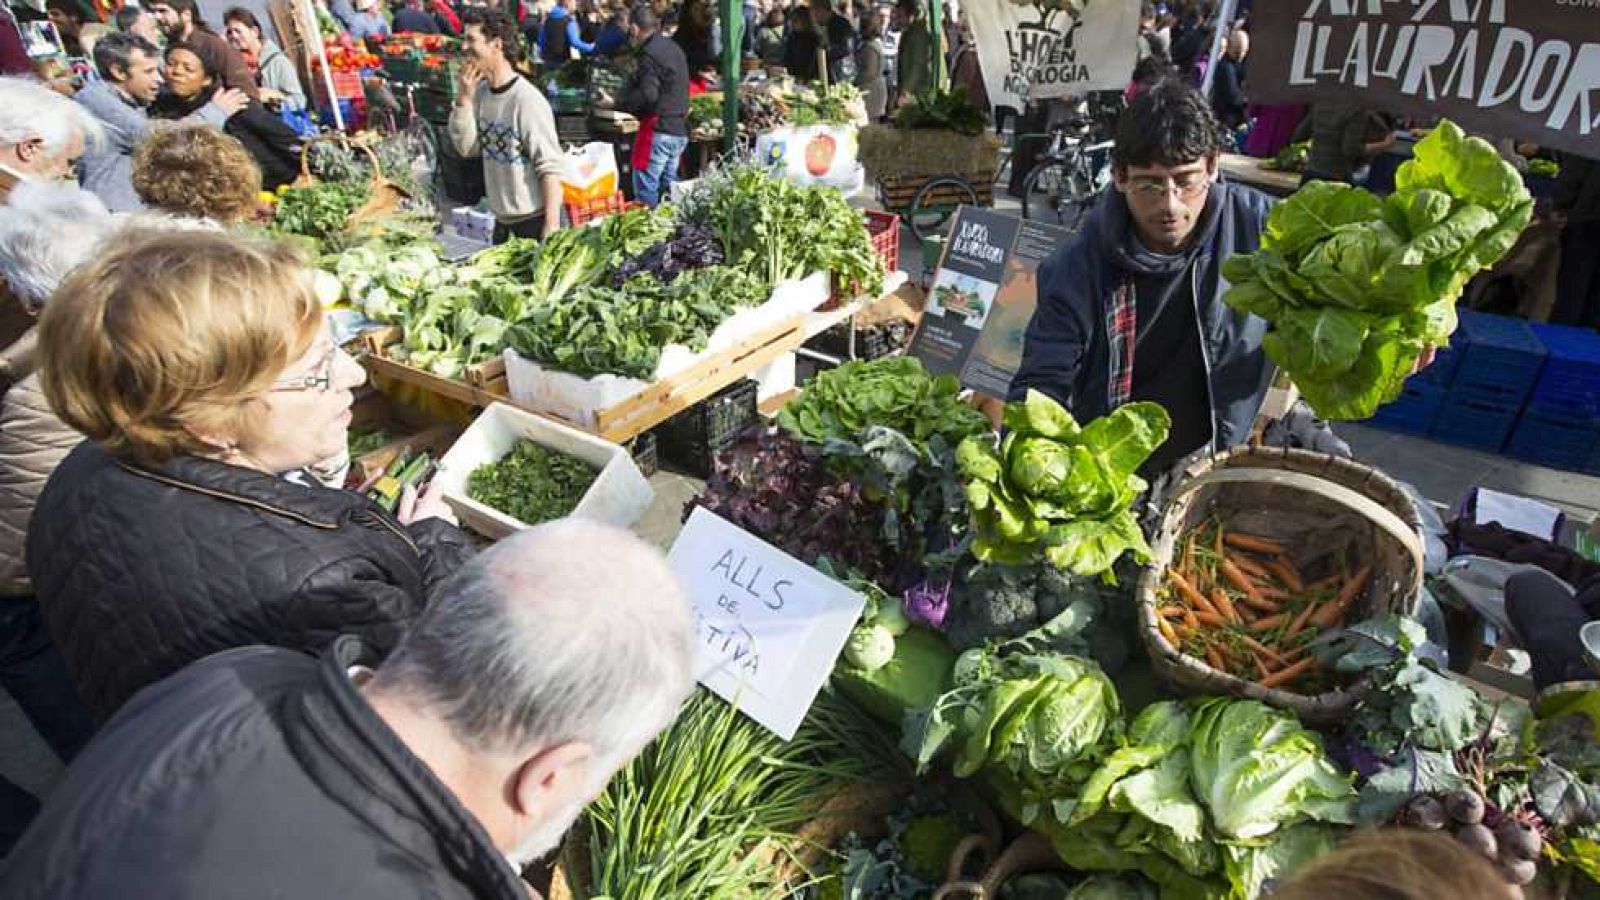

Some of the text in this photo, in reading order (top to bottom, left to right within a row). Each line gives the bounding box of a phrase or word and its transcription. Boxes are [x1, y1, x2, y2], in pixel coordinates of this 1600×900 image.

[1289, 21, 1600, 135] LLAURADOR
[711, 548, 793, 611] ALLS
[718, 594, 740, 615] DE
[697, 613, 759, 676] TIVA
